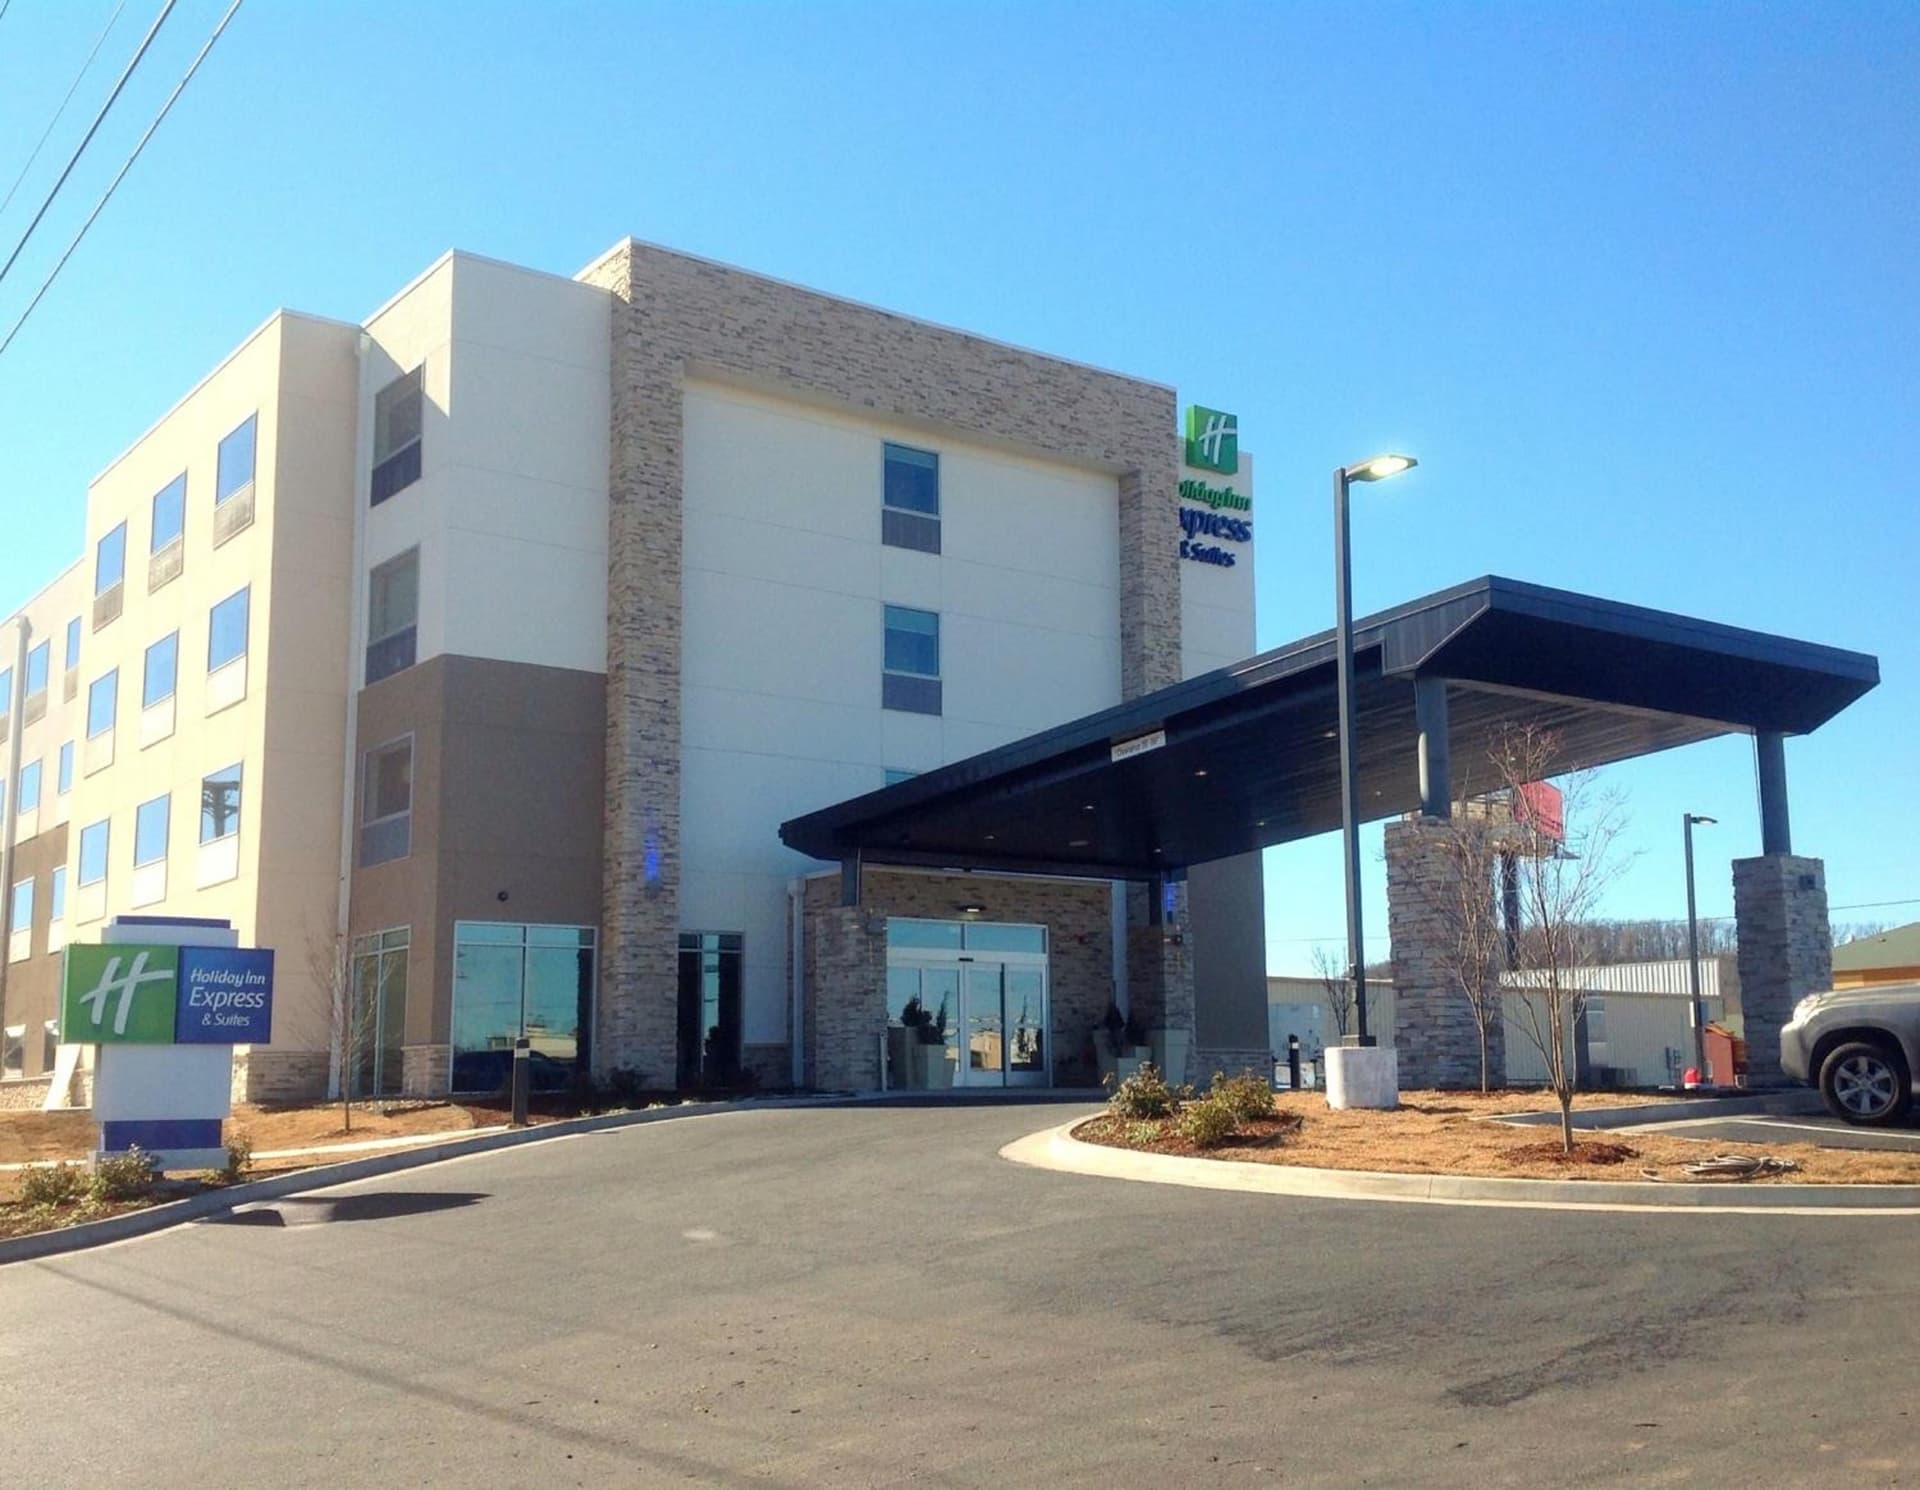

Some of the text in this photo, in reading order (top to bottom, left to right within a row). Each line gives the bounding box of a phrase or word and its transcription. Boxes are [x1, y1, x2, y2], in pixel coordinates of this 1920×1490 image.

[1190, 543, 1236, 568] Suites
[190, 968, 266, 988] Holiday Inn
[189, 986, 265, 1012] Express
[201, 1012, 251, 1026] & Suites
